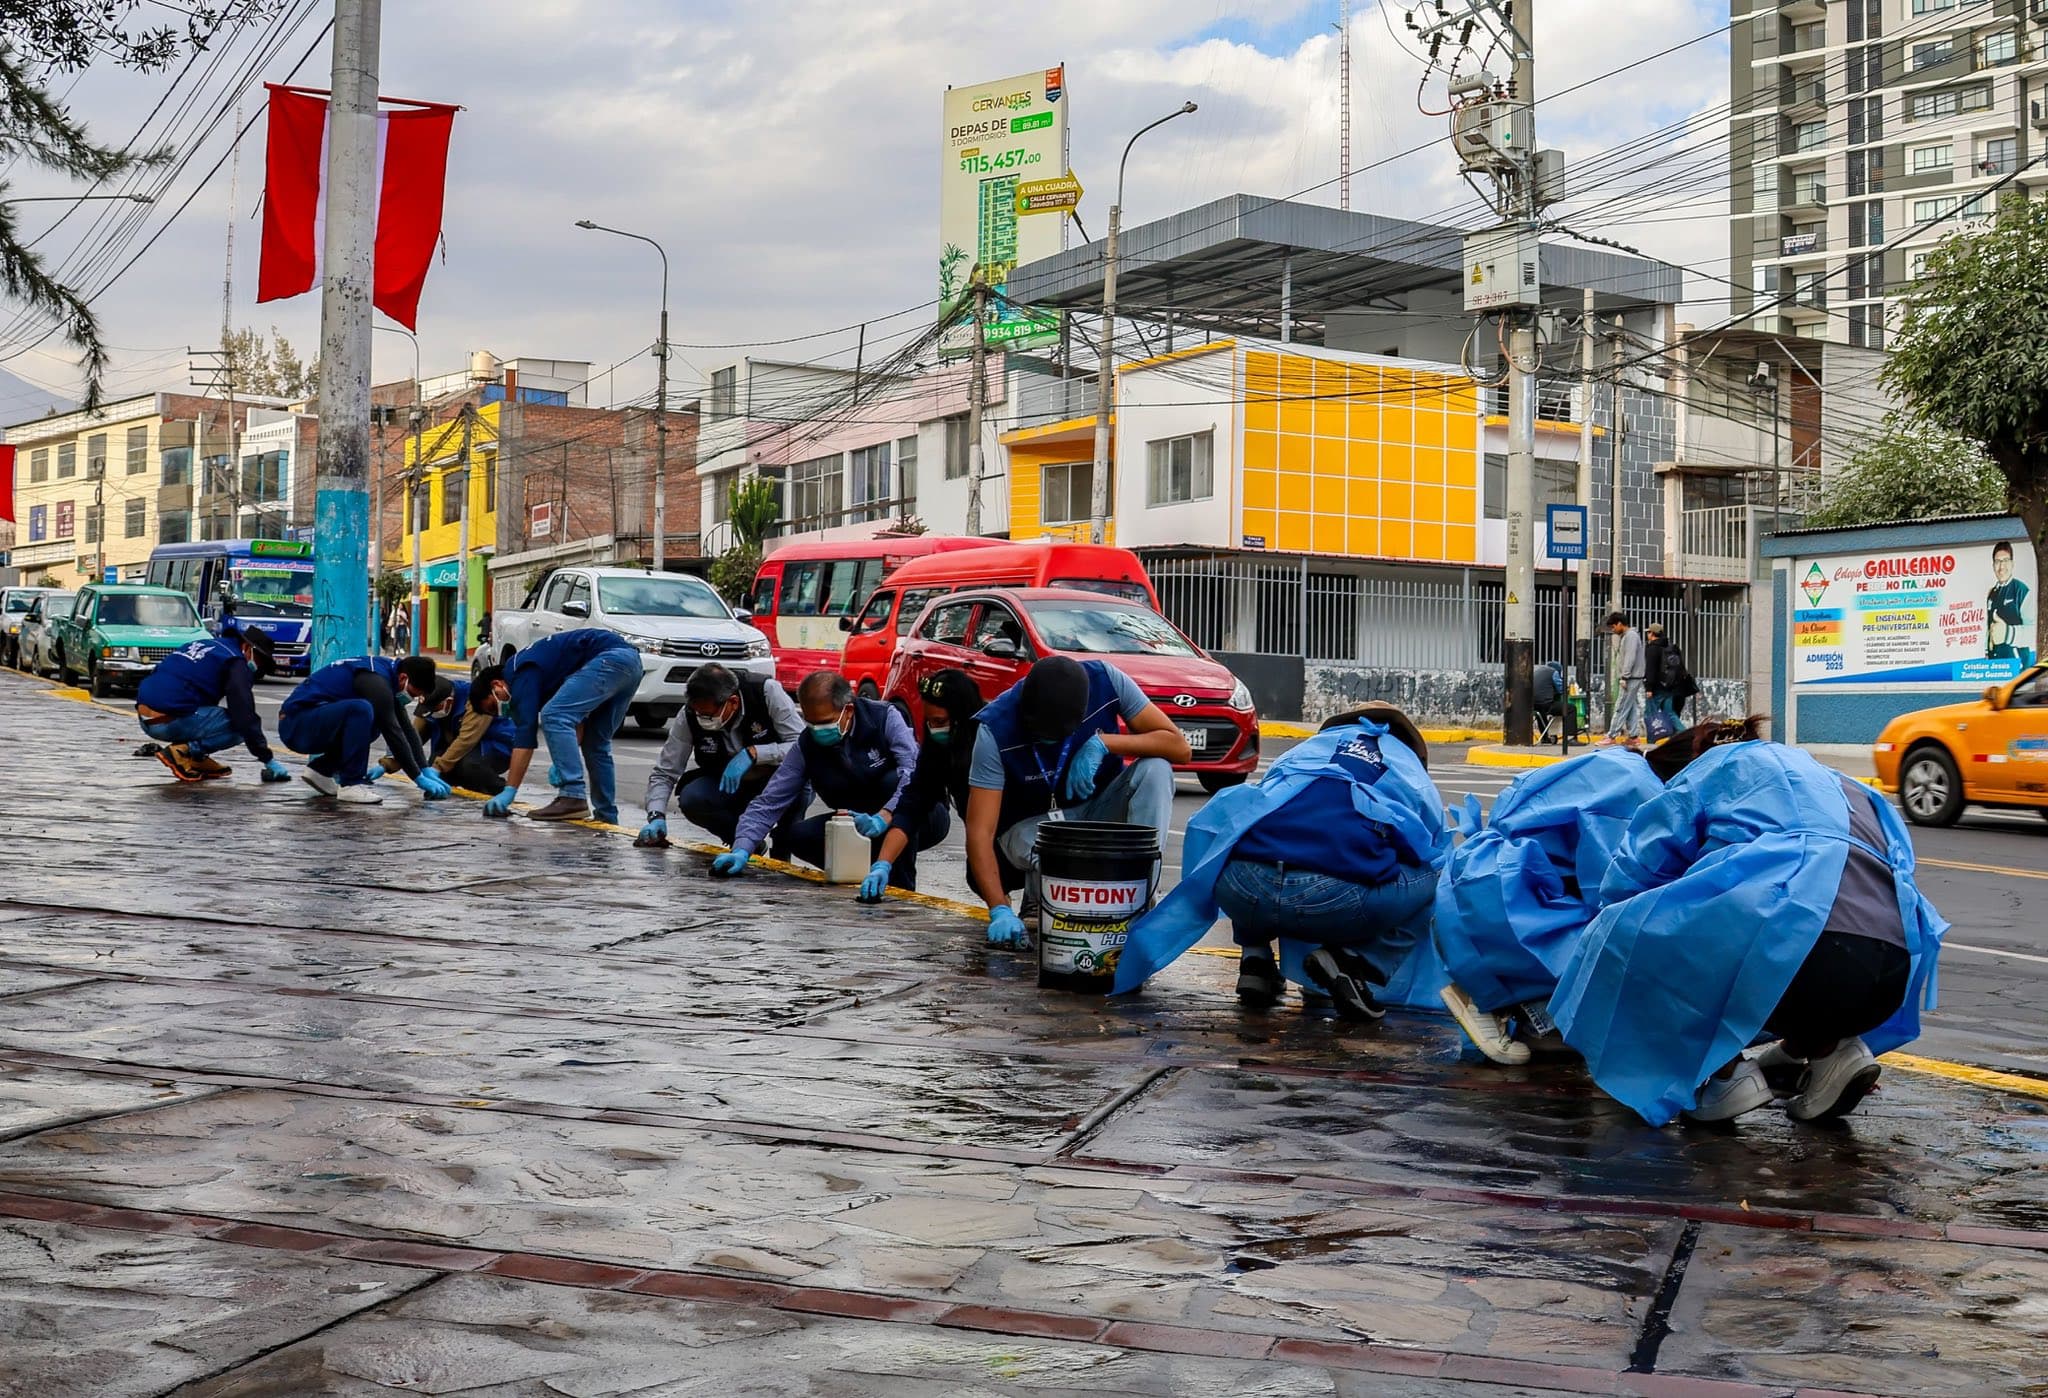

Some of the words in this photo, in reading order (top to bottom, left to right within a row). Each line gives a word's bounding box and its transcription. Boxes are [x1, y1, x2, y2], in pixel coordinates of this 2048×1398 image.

[972, 91, 1032, 112] CERVANTES
[951, 122, 988, 138] DEPAS
[992, 118, 1007, 130] DE
[957, 131, 1007, 146] DORMITORIOS
[1027, 185, 1044, 193] UNA
[1045, 181, 1078, 191] CUADRA
[991, 327, 1011, 338] 934
[1013, 325, 1031, 336] 819
[1552, 545, 1582, 554] PARADERO
[1834, 566, 1862, 582] Colegio
[1864, 555, 1956, 579] GALILEANO
[1856, 580, 1900, 592] PENO
[1902, 578, 1946, 590] ITAANO
[1875, 613, 1916, 623] ENSEÑANZA
[1862, 622, 1930, 632] PRE-UNIVERSITARIA
[1807, 652, 1843, 663] ADMISIÓN
[1826, 662, 1843, 670] 2025
[1050, 884, 1137, 904] VISTONY
[1101, 933, 1128, 946] HD
[1080, 957, 1092, 968] 40
